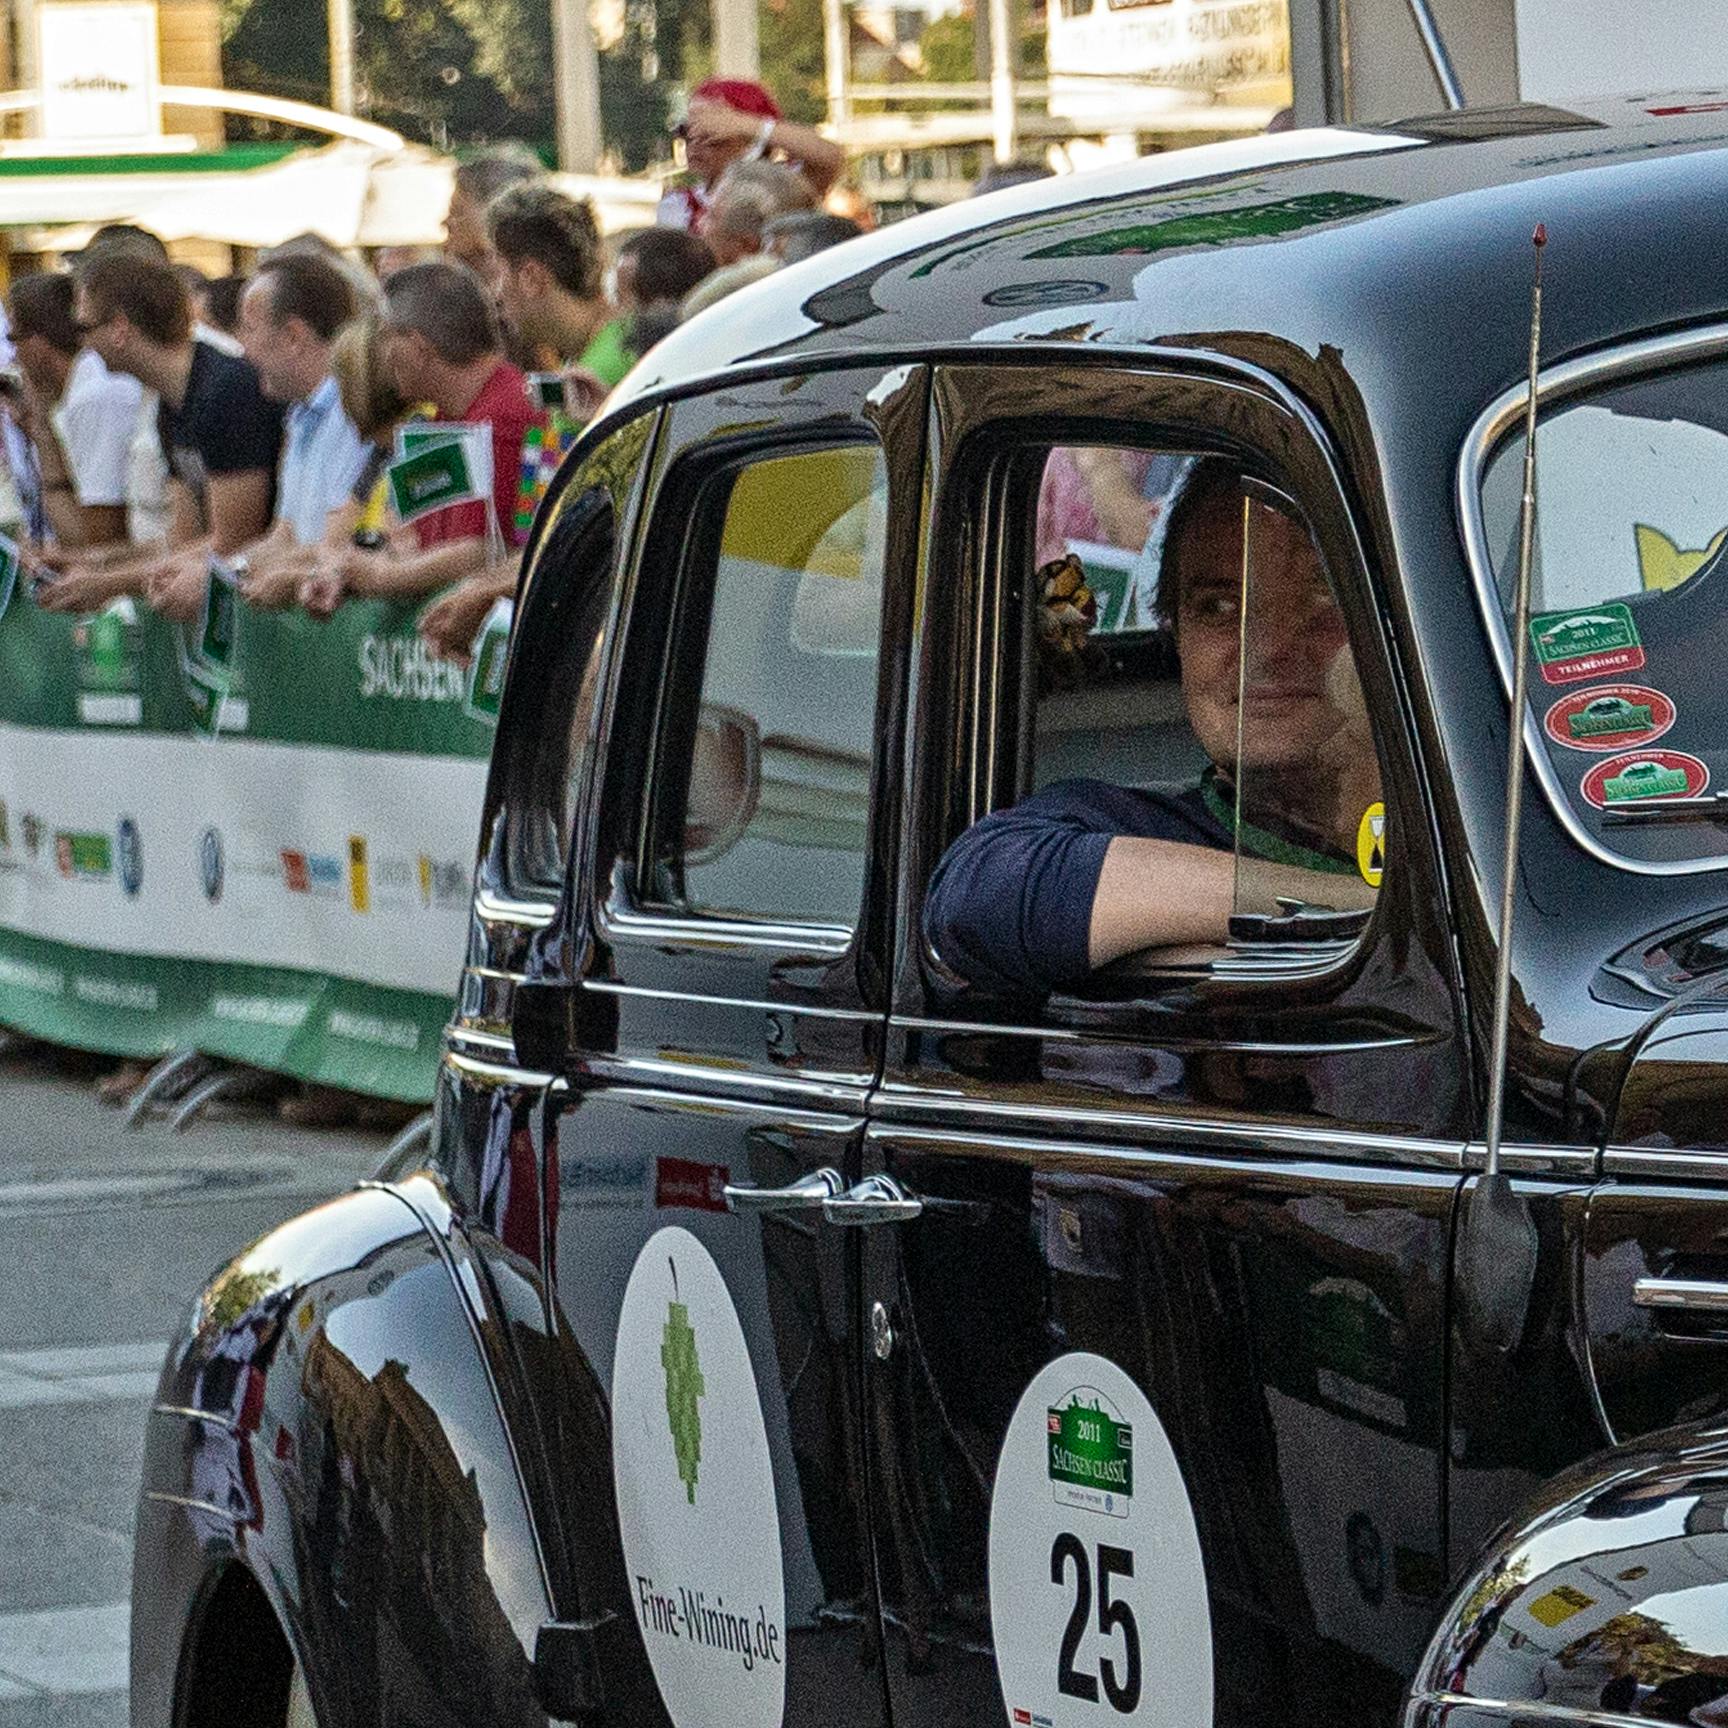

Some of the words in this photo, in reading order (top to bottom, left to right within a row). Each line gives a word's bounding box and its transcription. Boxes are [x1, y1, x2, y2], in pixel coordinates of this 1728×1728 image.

[1572, 628, 1597, 638] 2011
[1558, 655, 1630, 674] TEILNEHMER
[1078, 1420, 1101, 1443] 2011
[1052, 1444, 1093, 1477] SACHSEN
[1094, 1458, 1128, 1485] CLASSIC
[636, 1575, 781, 1671] Fine-Wining.de
[1050, 1532, 1142, 1715] 25
